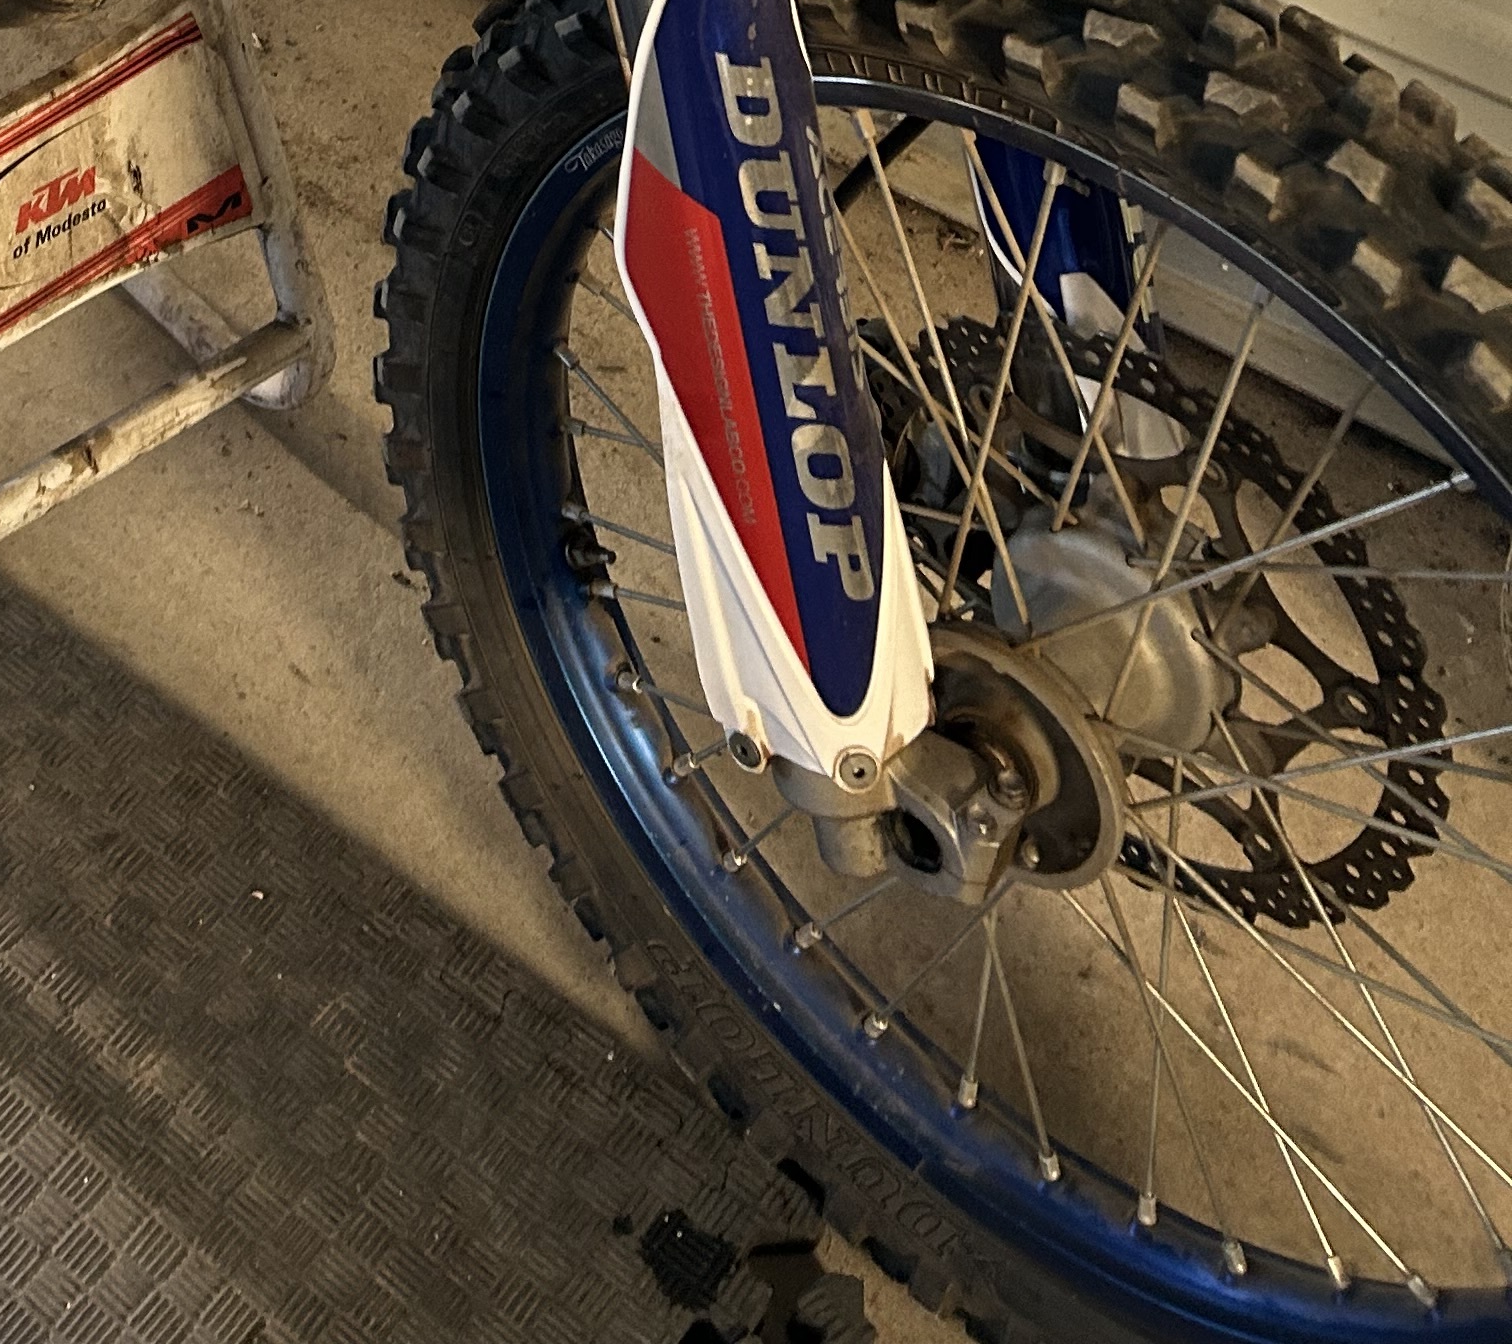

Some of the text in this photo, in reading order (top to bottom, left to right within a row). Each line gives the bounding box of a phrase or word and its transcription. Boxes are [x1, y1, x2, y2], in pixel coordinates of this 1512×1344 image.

[13, 197, 108, 261] of Modesto
[15, 165, 96, 235] KTM
[716, 50, 876, 603] DUNLOP
